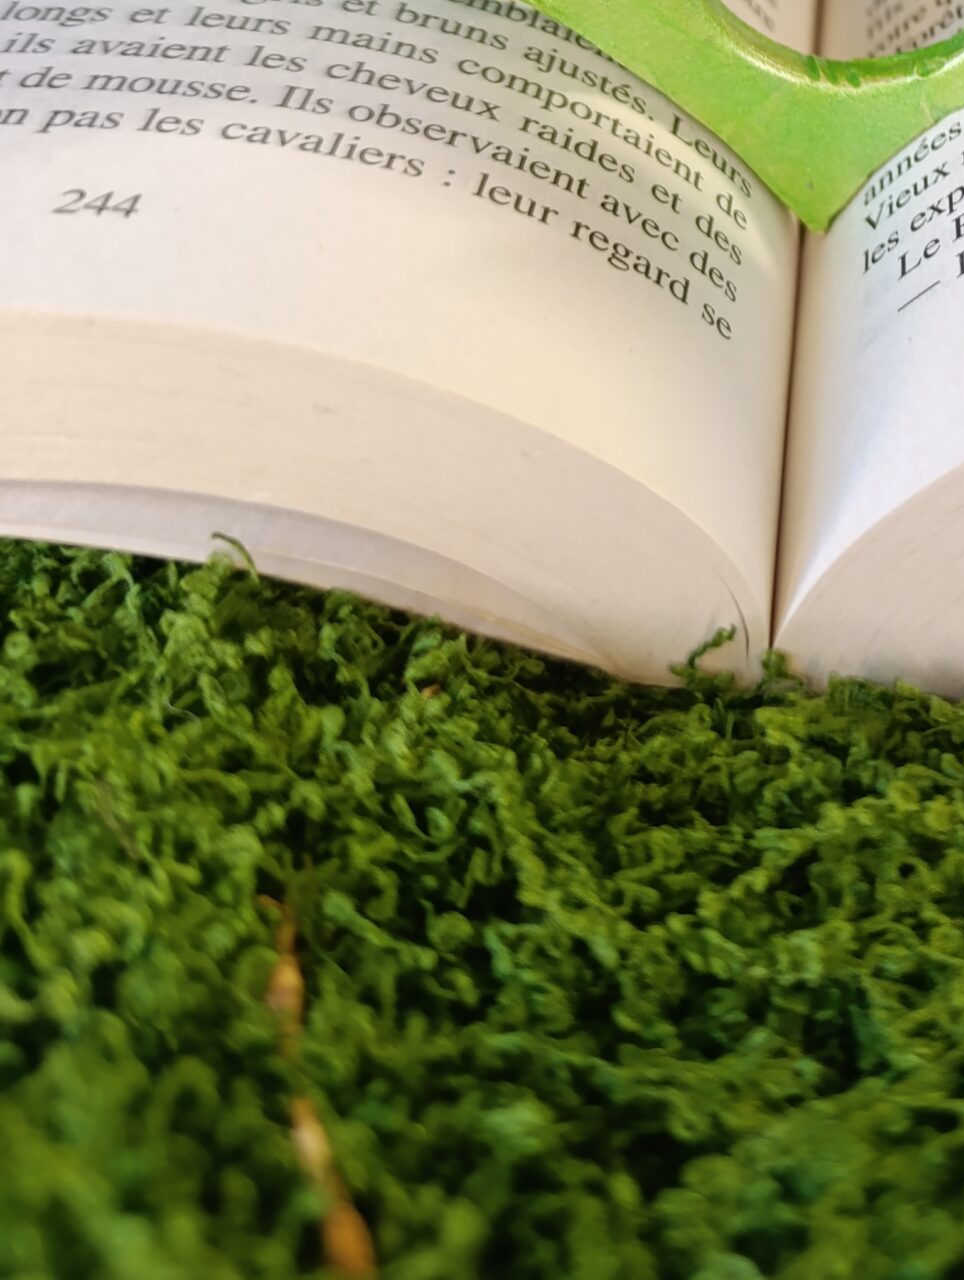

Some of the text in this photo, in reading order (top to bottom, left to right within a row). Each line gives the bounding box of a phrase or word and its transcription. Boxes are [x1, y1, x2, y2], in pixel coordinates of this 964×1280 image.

[0, 32, 743, 266] ils avaient les cheveux raides et des
[1, 1, 748, 230] longs et leurs mains comportaient de
[394, 2, 510, 51] bruns
[523, 44, 654, 121] ajustés.
[672, 112, 753, 199] Leurs
[864, 121, 962, 207] années
[19, 66, 73, 90] de
[81, 73, 258, 105] mousse.
[274, 85, 334, 116] Ils
[348, 103, 592, 200] observaient
[600, 192, 681, 252] avec
[688, 246, 738, 303] des
[34, 107, 125, 135] pas
[137, 108, 204, 136] les
[221, 122, 425, 178] cavaliers
[471, 171, 560, 227] leur
[569, 219, 691, 305] regard
[701, 301, 733, 341] se
[52, 188, 143, 218] 244
[863, 230, 900, 274] les
[864, 161, 950, 231] Vieux
[898, 237, 941, 280] Le
